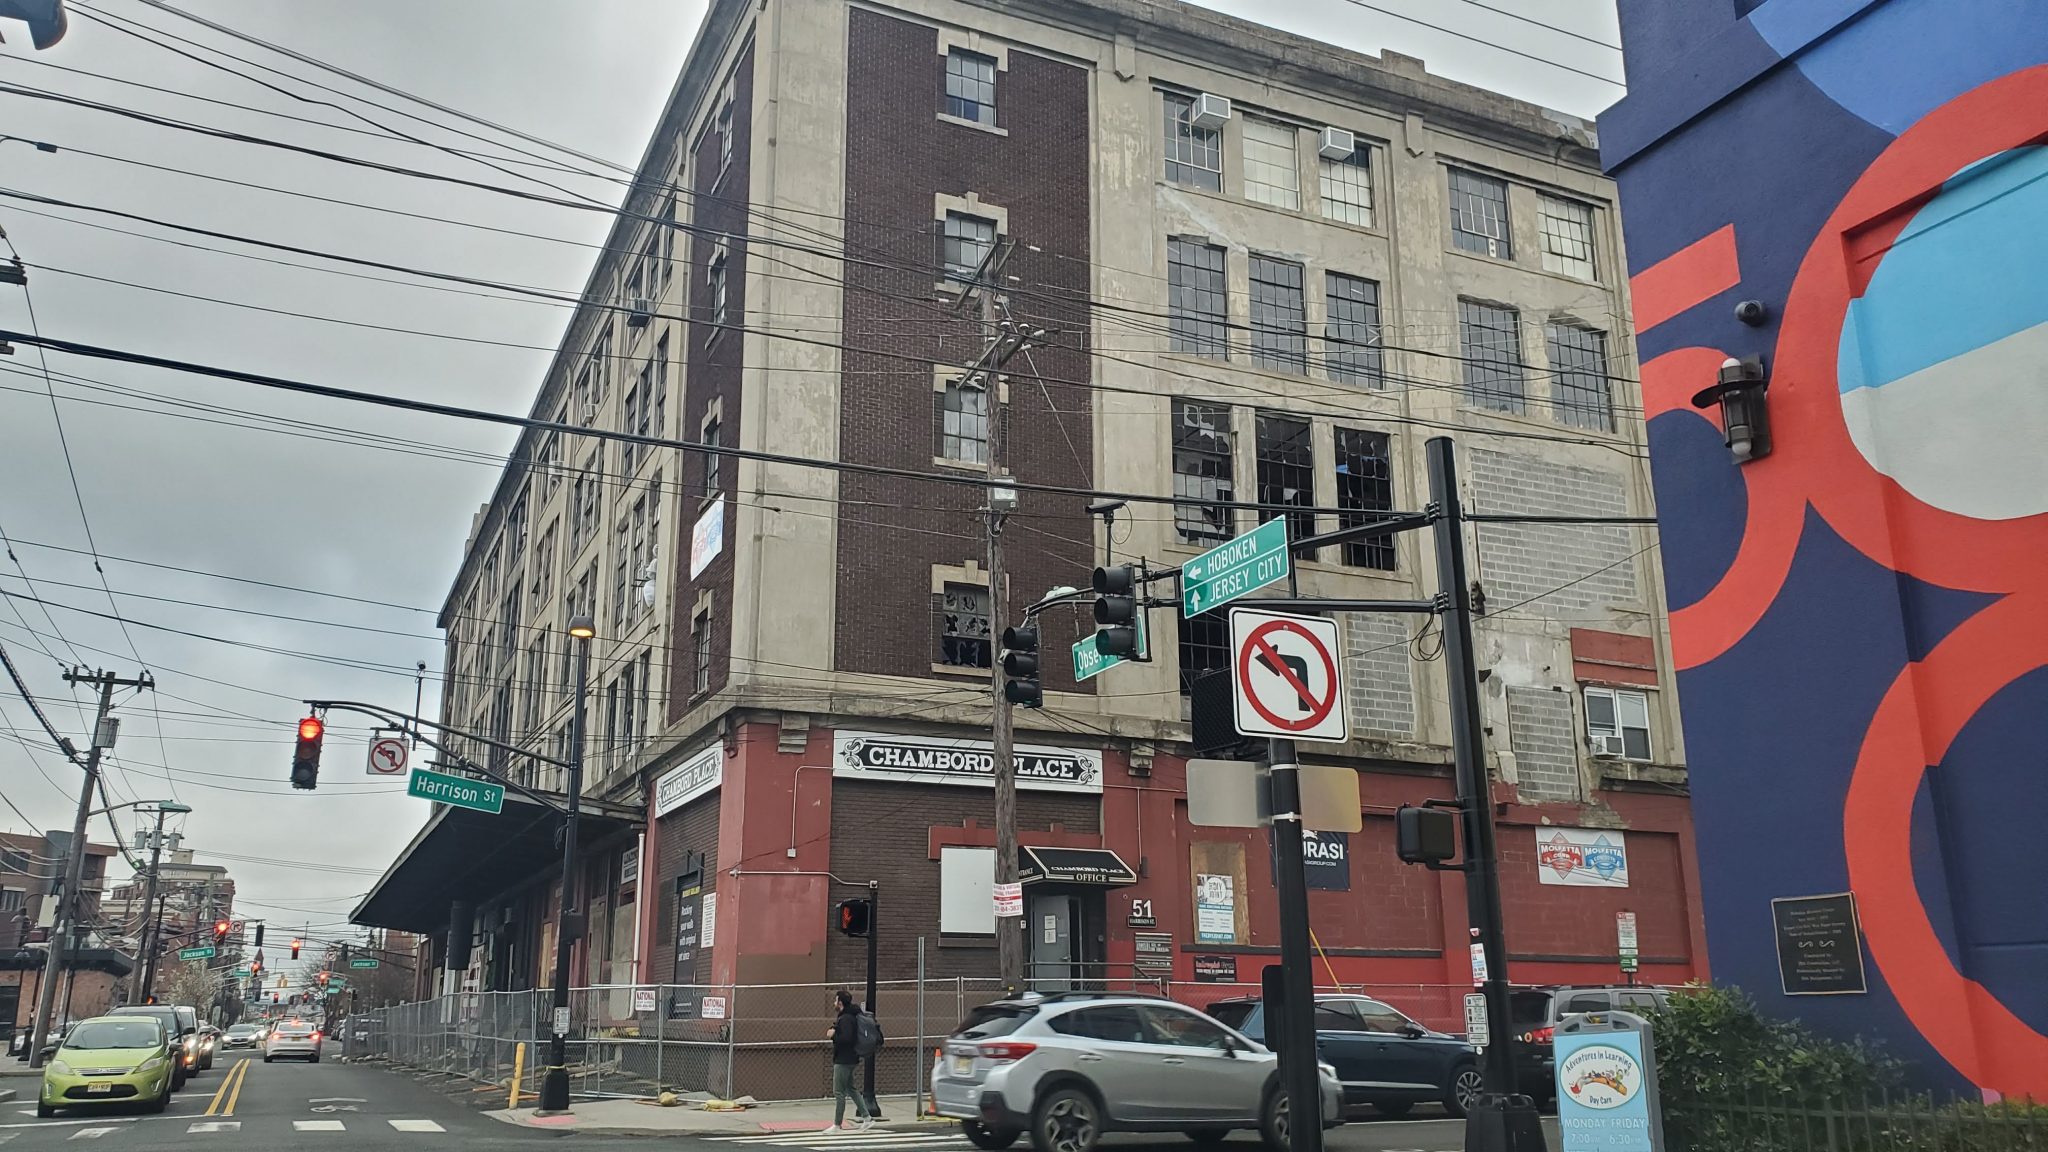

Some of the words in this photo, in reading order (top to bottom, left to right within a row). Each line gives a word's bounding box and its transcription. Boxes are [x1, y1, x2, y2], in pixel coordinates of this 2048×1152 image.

[1207, 536, 1257, 575] HOBOKEN
[1209, 569, 1250, 603] JERSEY
[1257, 553, 1282, 581] CITY
[868, 746, 994, 772] CHAMBORD
[693, 758, 714, 785] PLACE
[416, 775, 478, 802] Harrison
[483, 789, 496, 803] St
[1076, 873, 1107, 882] OFFICE
[1132, 899, 1152, 918] 51
[636, 992, 654, 1001] NATIONAL
[703, 998, 724, 1008] NATIONAL
[1565, 1052, 1598, 1074] Adventures
[1604, 1050, 1632, 1070] Learning
[1589, 1095, 1599, 1106] Day
[1600, 1095, 1612, 1104] Care
[1564, 1118, 1606, 1128] MONDAY
[1611, 1118, 1645, 1128] FRIDAY
